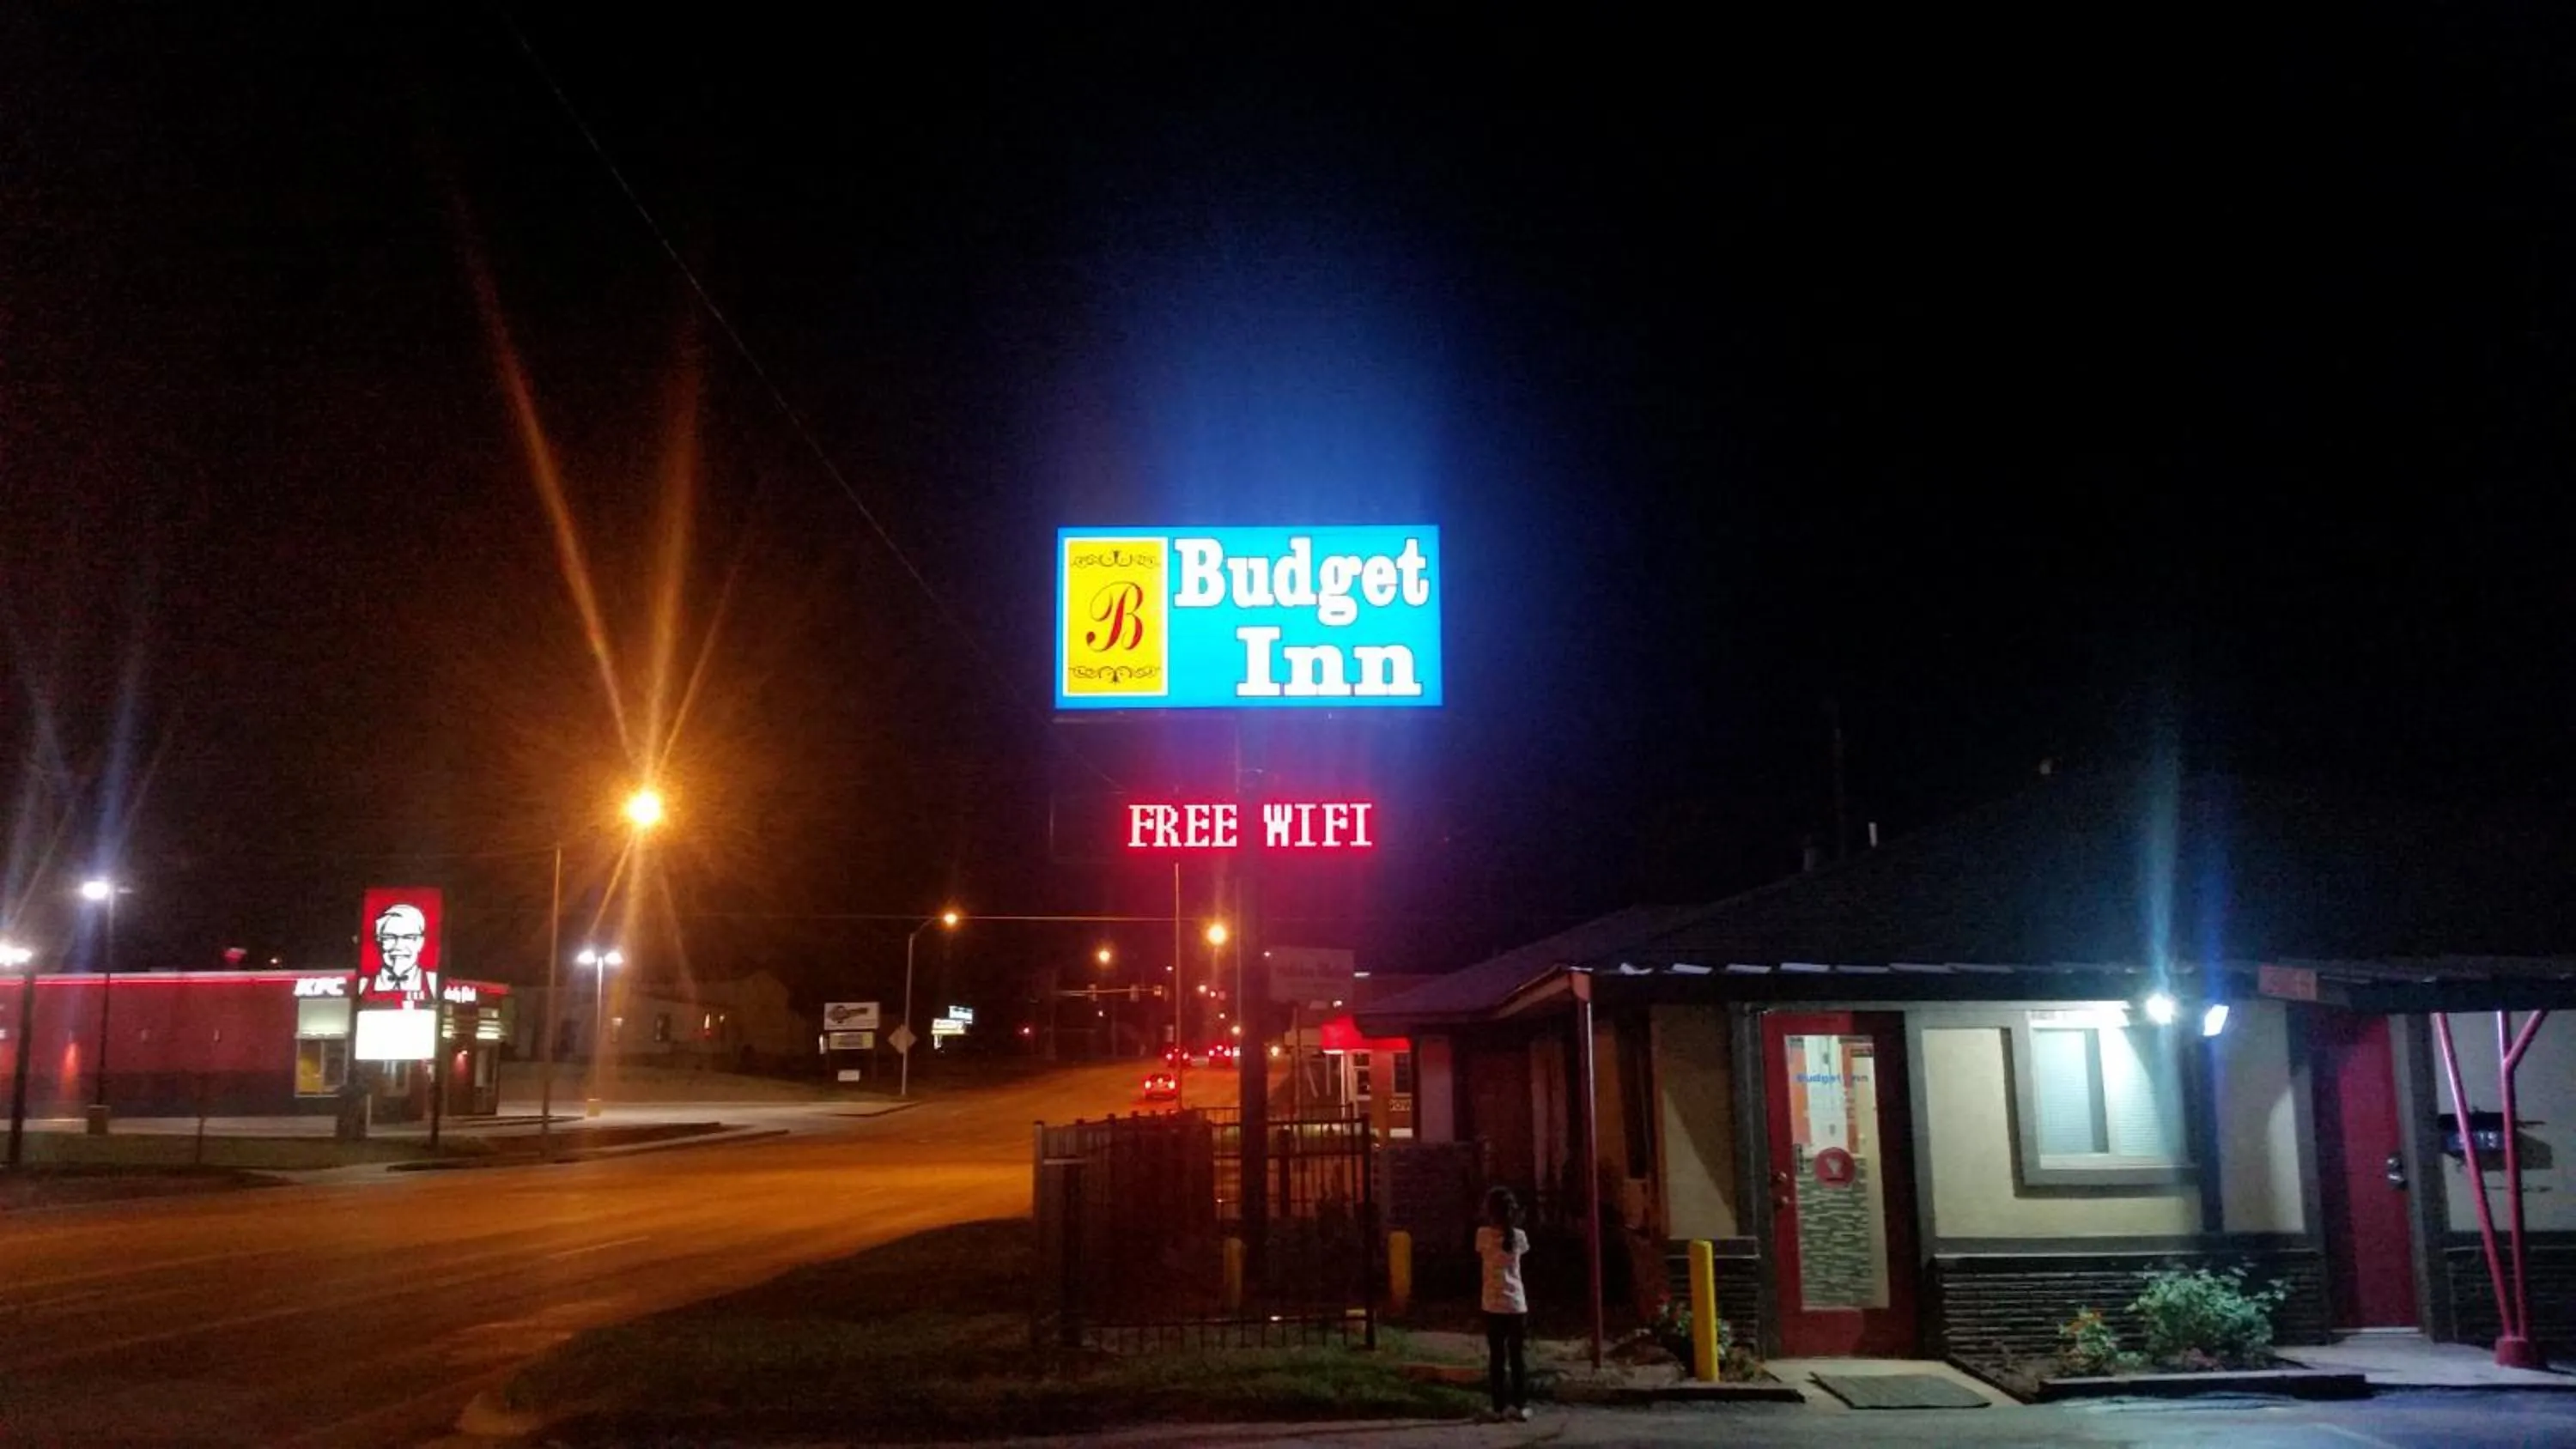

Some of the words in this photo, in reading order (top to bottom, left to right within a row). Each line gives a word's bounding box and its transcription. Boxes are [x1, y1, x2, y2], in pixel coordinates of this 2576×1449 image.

[1085, 581, 1143, 652] B
[1174, 537, 1429, 626] Budget
[1236, 626, 1422, 697] Inn
[1128, 804, 1237, 847] FREE
[1264, 803, 1372, 846] WIFI
[294, 978, 346, 996] KFC
